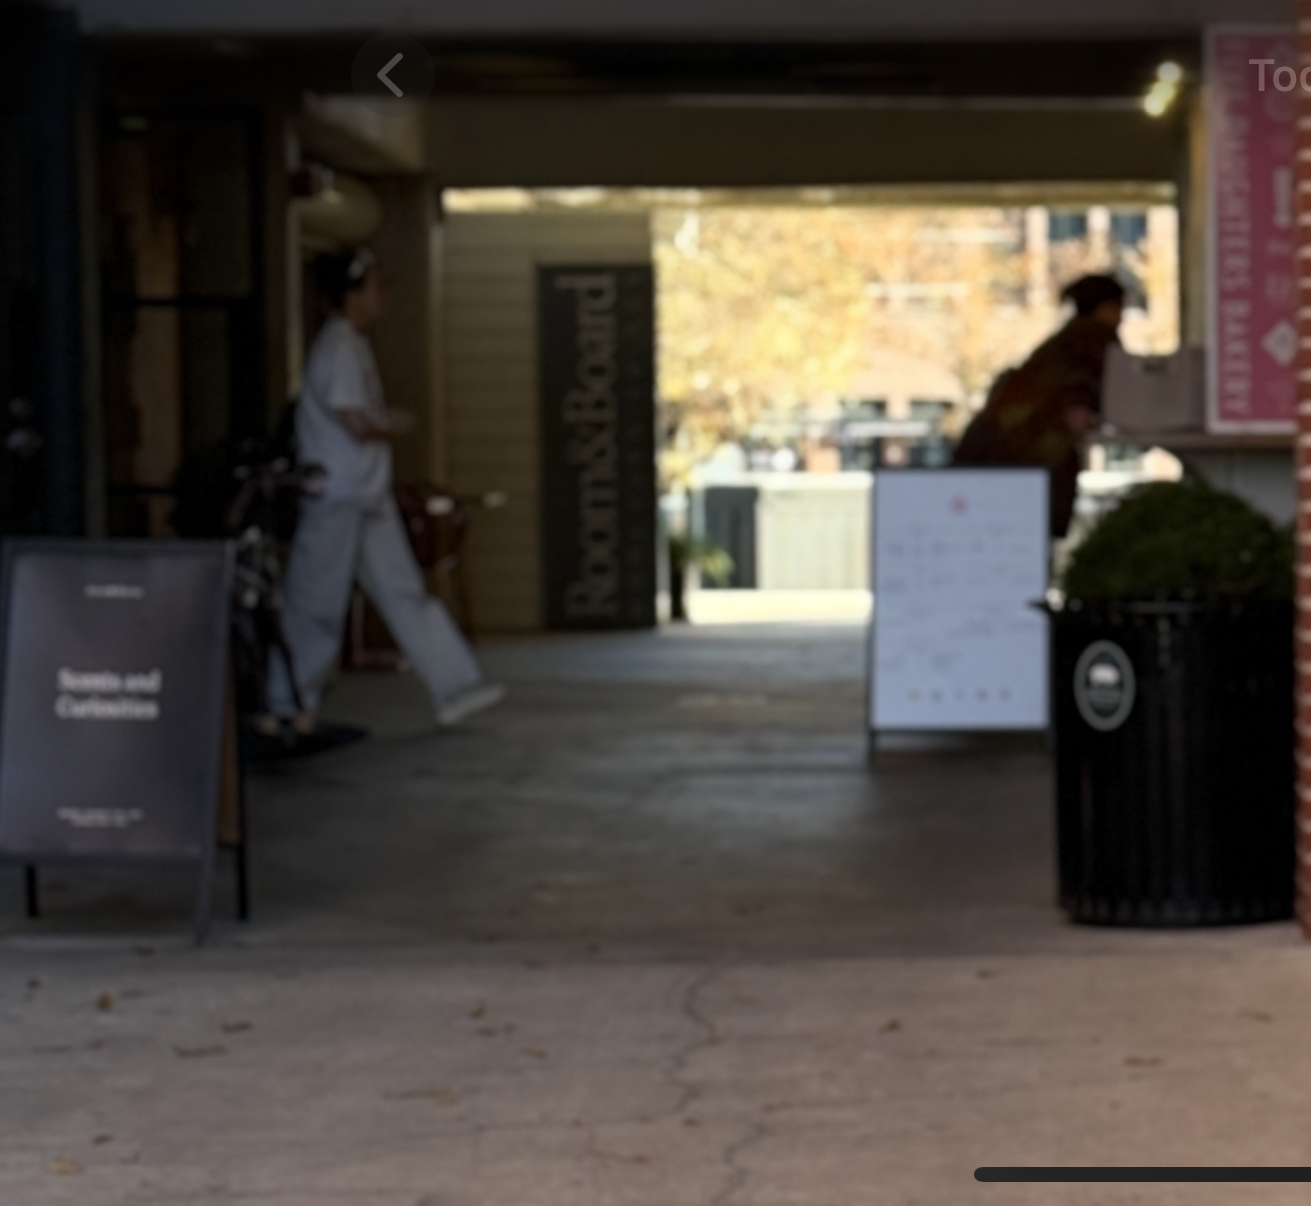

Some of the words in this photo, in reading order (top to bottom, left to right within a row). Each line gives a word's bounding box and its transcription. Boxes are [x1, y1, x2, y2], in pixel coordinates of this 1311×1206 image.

[1221, 112, 1251, 291] DAUGHTERS
[1222, 299, 1252, 415] BAKERY
[125, 667, 161, 693] and
